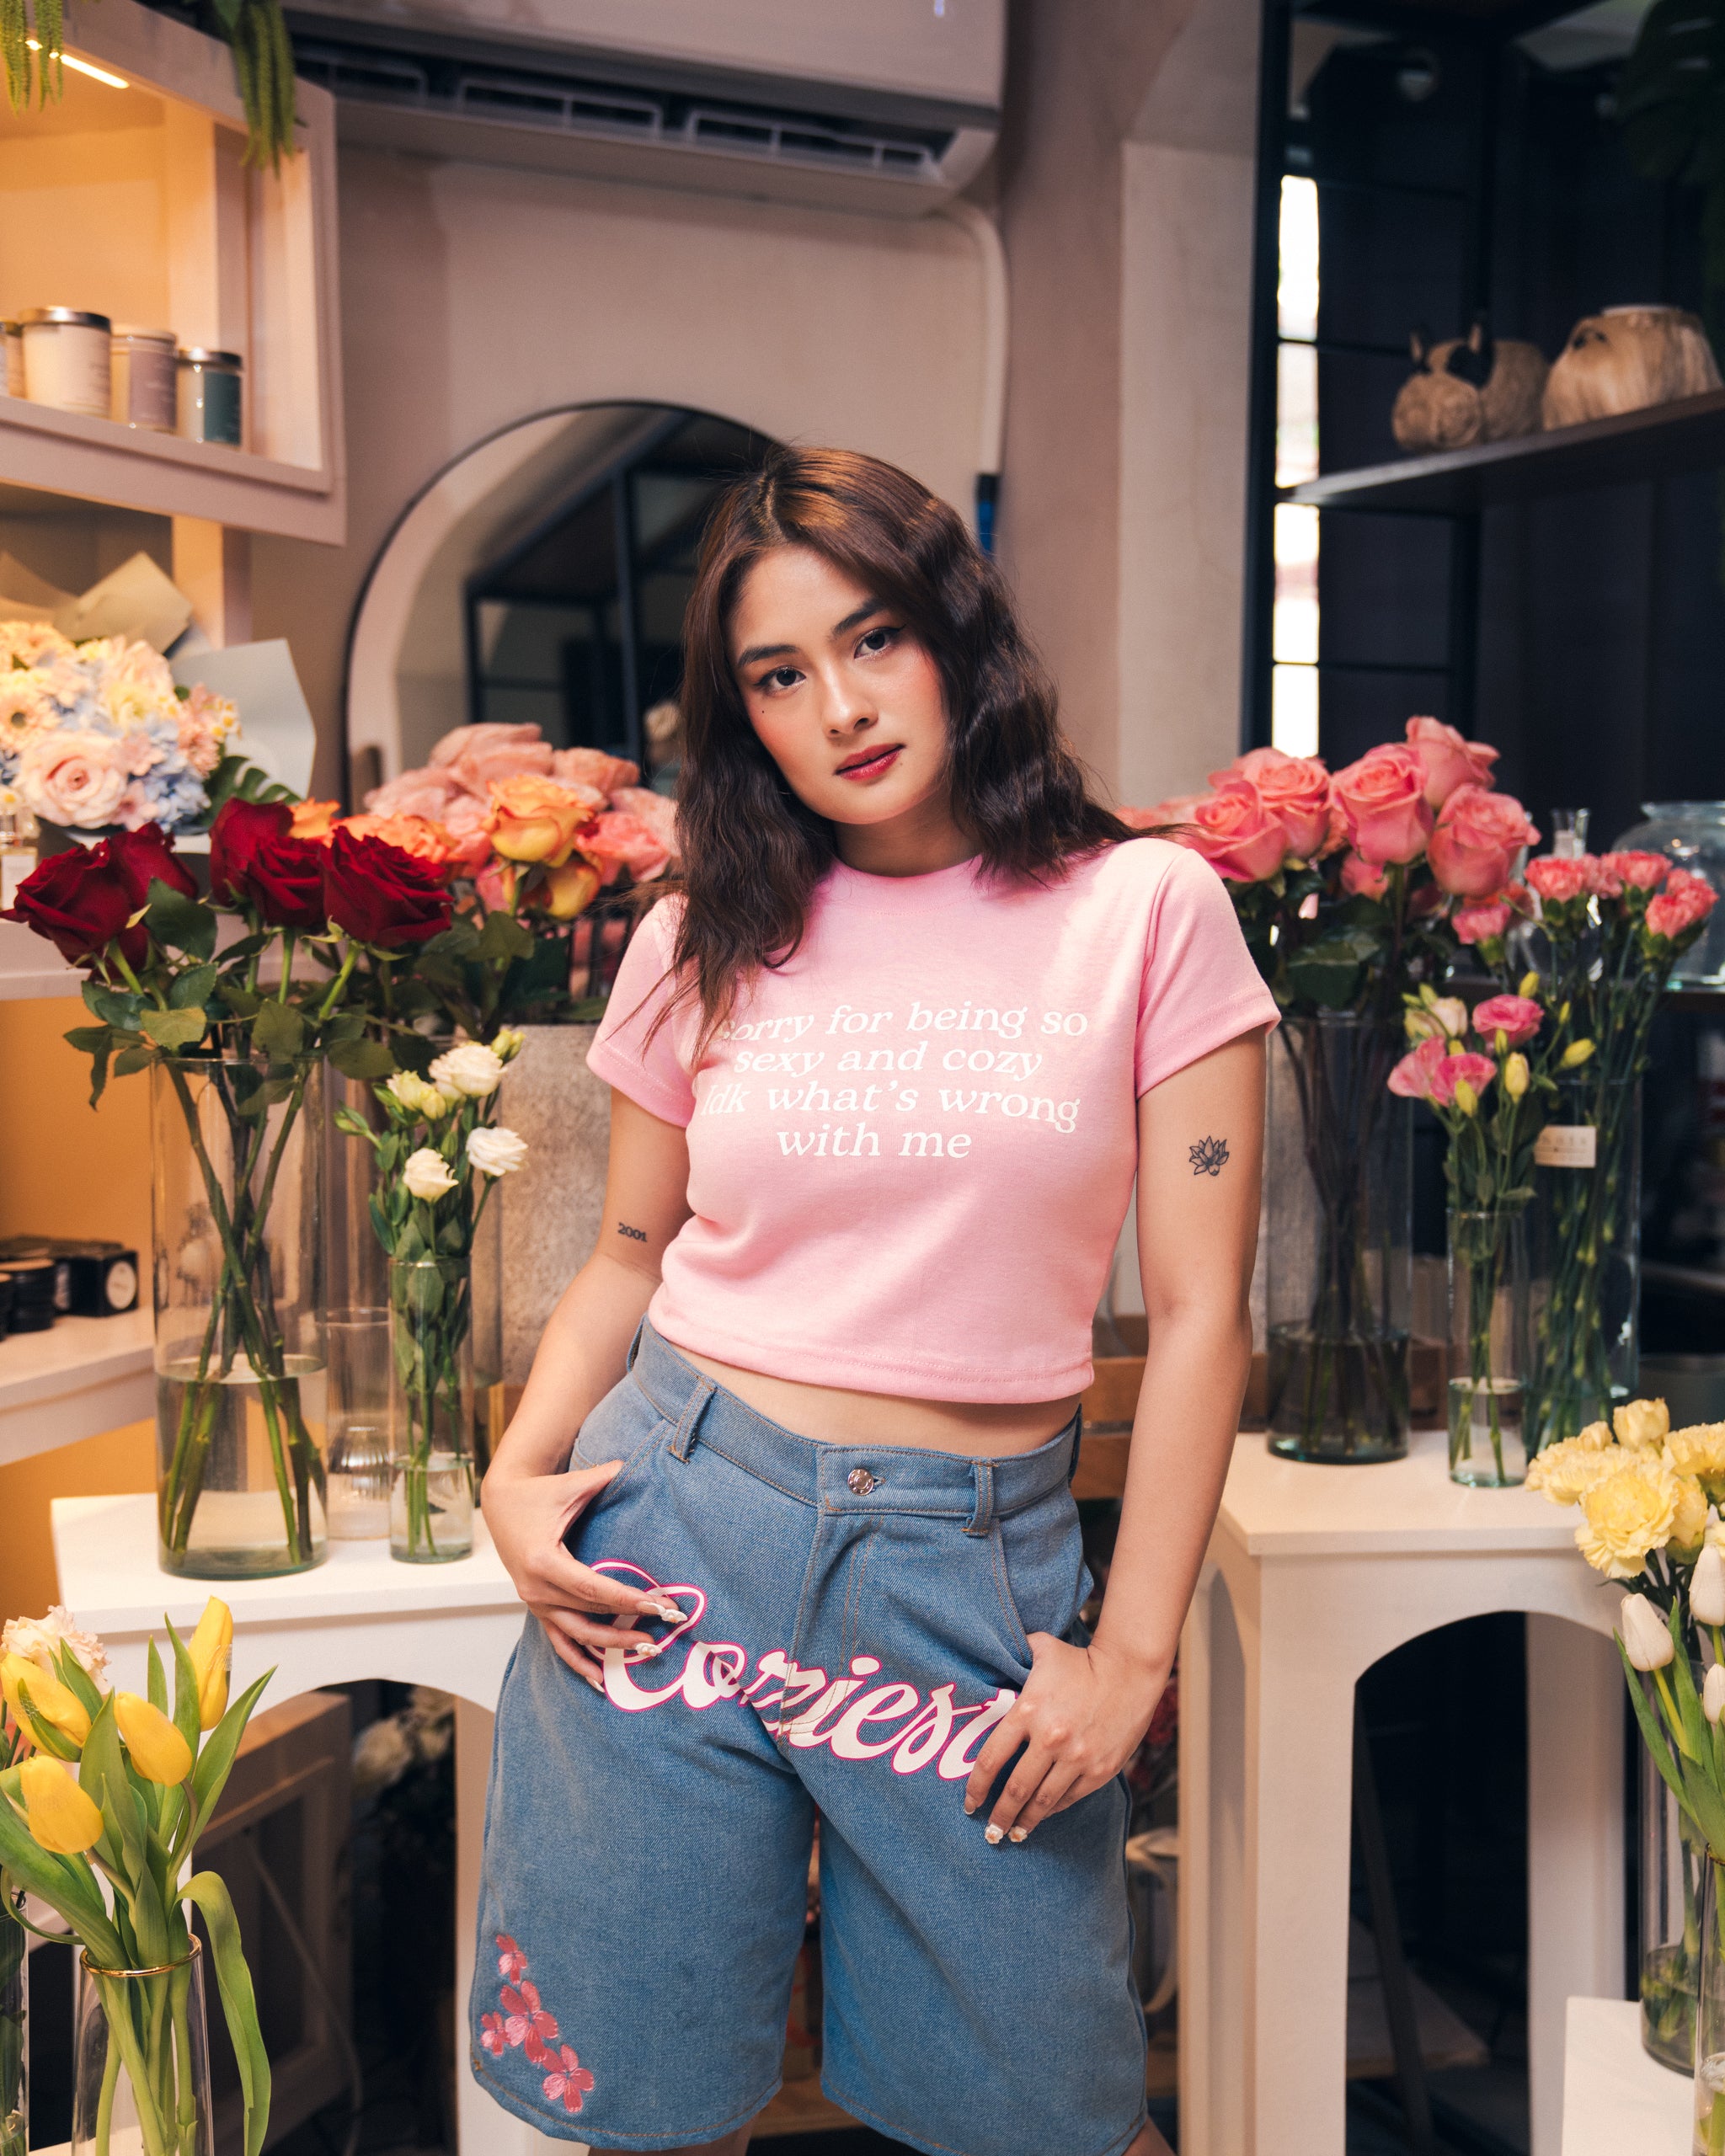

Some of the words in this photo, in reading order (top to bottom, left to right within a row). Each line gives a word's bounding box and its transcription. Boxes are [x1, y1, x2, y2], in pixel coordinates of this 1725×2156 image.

[825, 1006, 893, 1035] for
[906, 1001, 1027, 1038] being
[1040, 1010, 1087, 1036] so
[734, 1051, 825, 1078] sexy
[837, 1041, 928, 1071] and
[943, 1049, 1043, 1081] cozy
[767, 1081, 918, 1113] what's
[938, 1088, 1081, 1134] wrong
[777, 1123, 881, 1156] with
[898, 1131, 972, 1159] me
[617, 1222, 648, 1242] 2001
